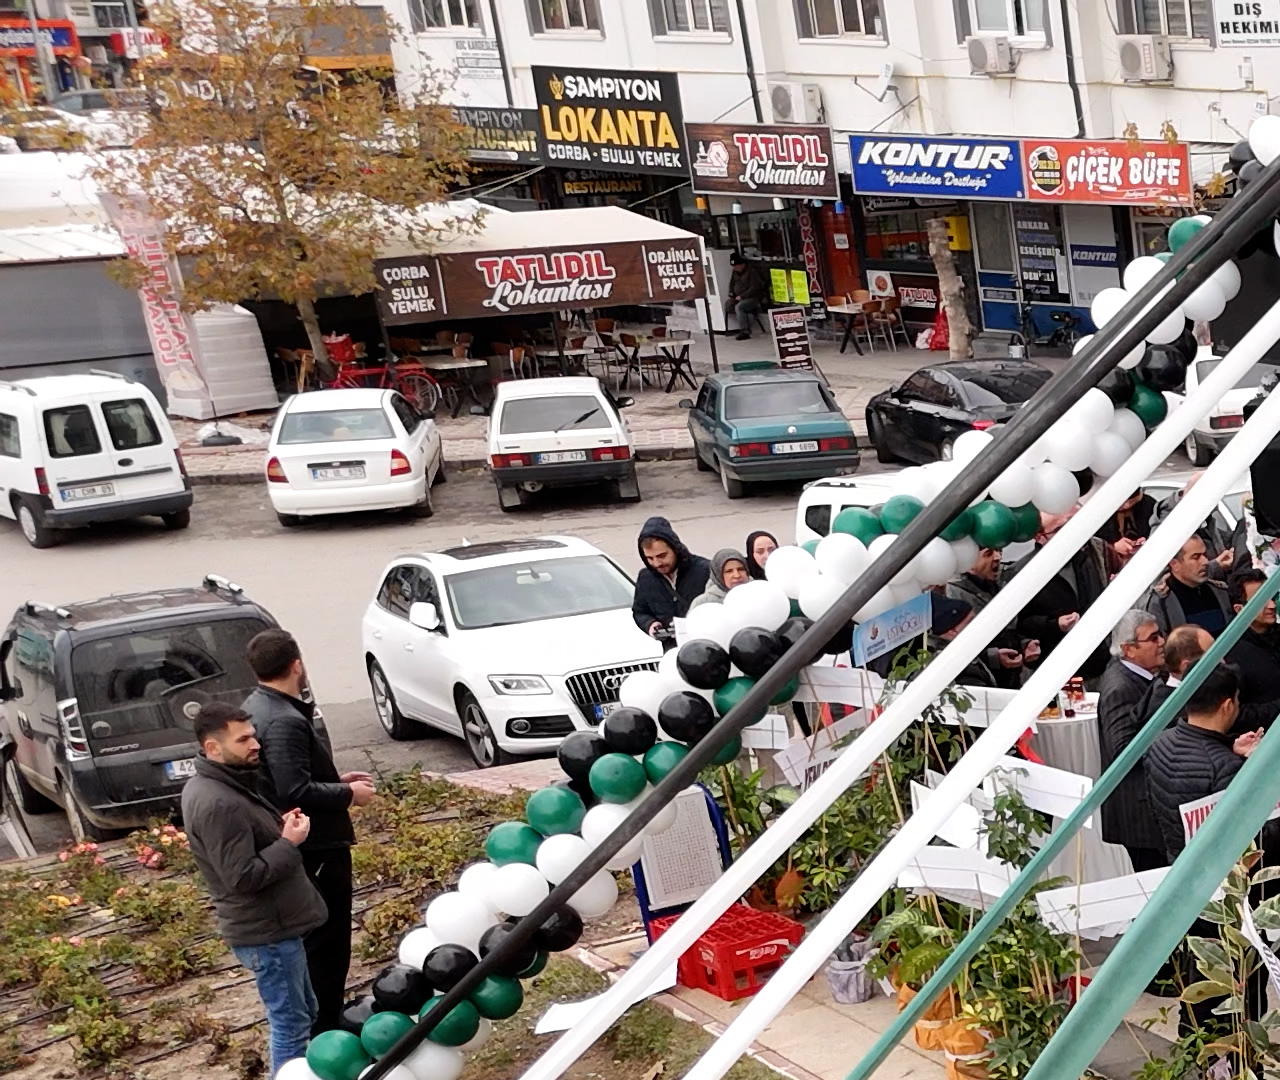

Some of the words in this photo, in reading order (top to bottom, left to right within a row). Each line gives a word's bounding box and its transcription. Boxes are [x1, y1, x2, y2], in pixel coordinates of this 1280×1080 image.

[1233, 3, 1262, 18] DİŞ
[1220, 21, 1279, 34] HEKİMİ
[563, 75, 662, 102] ŞAMPİYON
[541, 104, 680, 149] LOKANTA
[601, 148, 635, 165] SULU
[637, 150, 682, 168] YEMEK
[858, 141, 1011, 170] KONTUR
[1066, 150, 1124, 191] ÇİÇEK
[1128, 151, 1181, 186] BÜFE
[563, 179, 642, 194] RESTAURANT
[1016, 220, 1050, 230] ANKARA
[648, 247, 700, 265] ORJİNAL
[1072, 250, 1117, 262] KONTUR
[382, 265, 430, 283] ÇORBA
[656, 263, 695, 277] KELLE
[661, 276, 695, 291] PAÇA
[391, 286, 429, 301] SULU
[387, 298, 437, 316] YEMEK
[179, 760, 195, 772] 42
